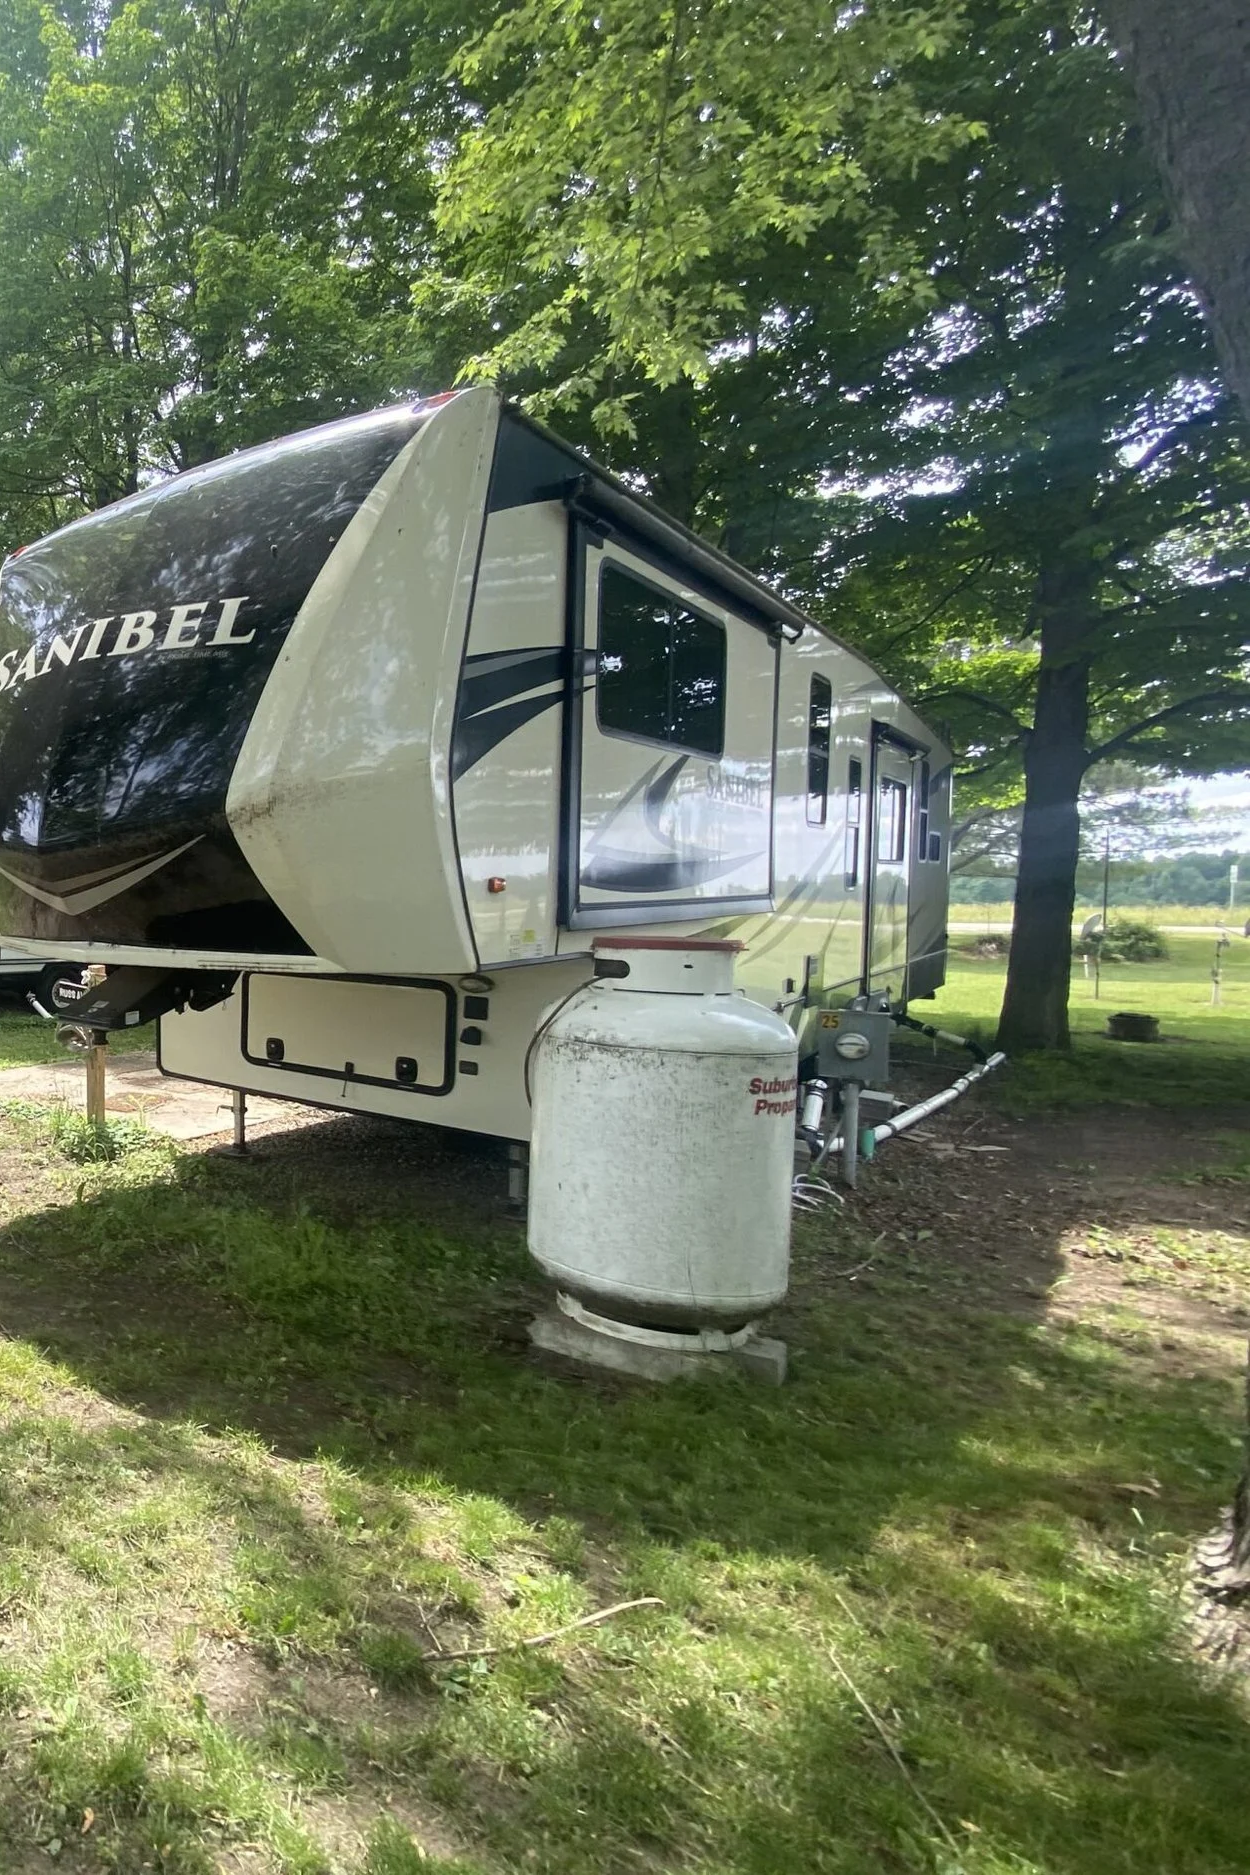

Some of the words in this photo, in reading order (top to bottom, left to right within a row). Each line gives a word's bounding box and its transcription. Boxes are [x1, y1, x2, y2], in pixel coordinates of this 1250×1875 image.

[821, 1015, 839, 1029] 25
[749, 1077, 798, 1094] Suburb
[754, 1099, 797, 1116] Propa
